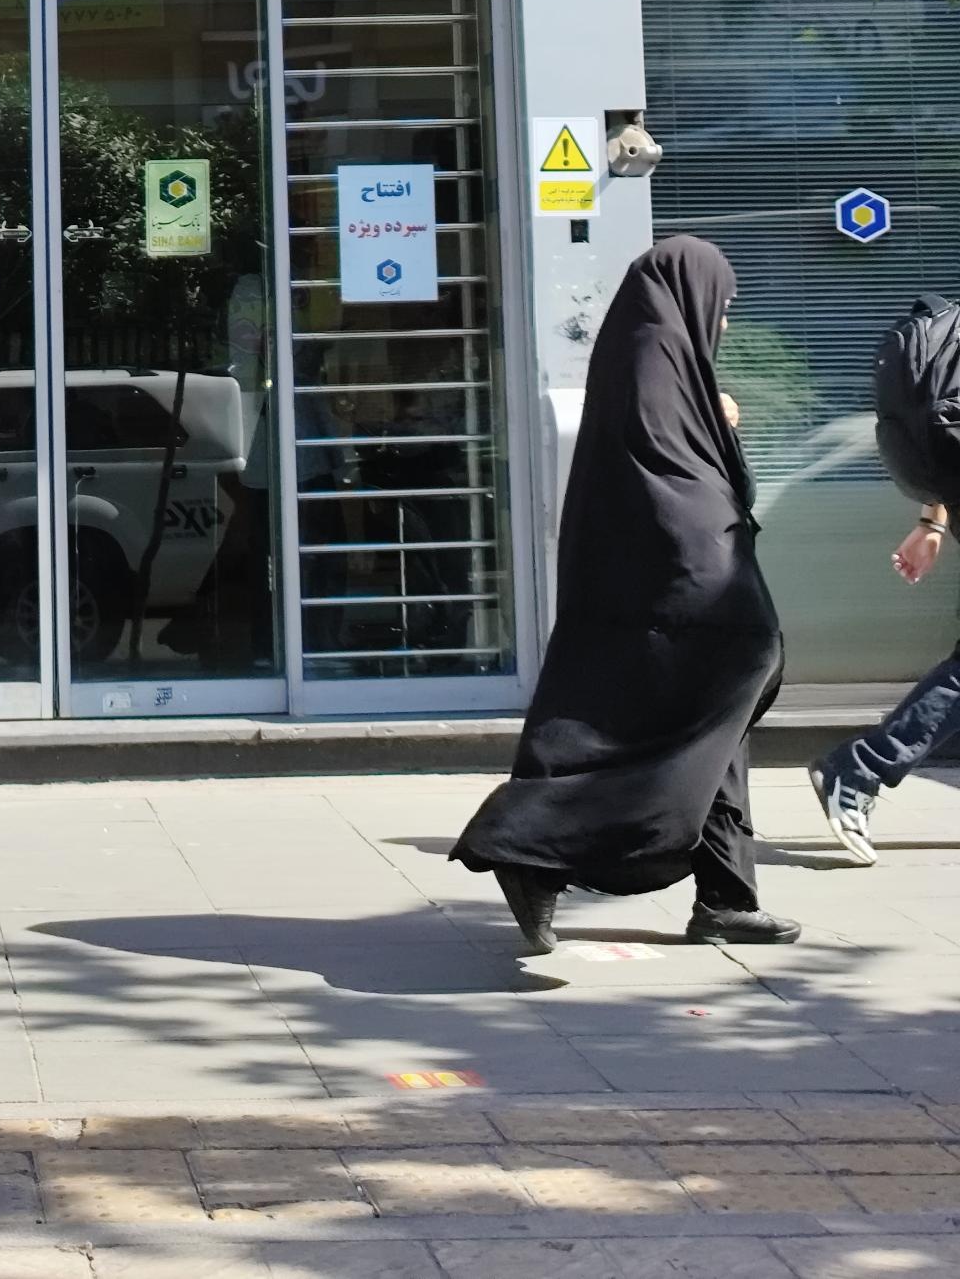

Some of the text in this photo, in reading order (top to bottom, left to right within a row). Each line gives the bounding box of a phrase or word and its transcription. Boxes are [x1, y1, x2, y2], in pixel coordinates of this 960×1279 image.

[360, 179, 412, 203] افتتاح
[348, 218, 429, 241] سپرده ویژه
